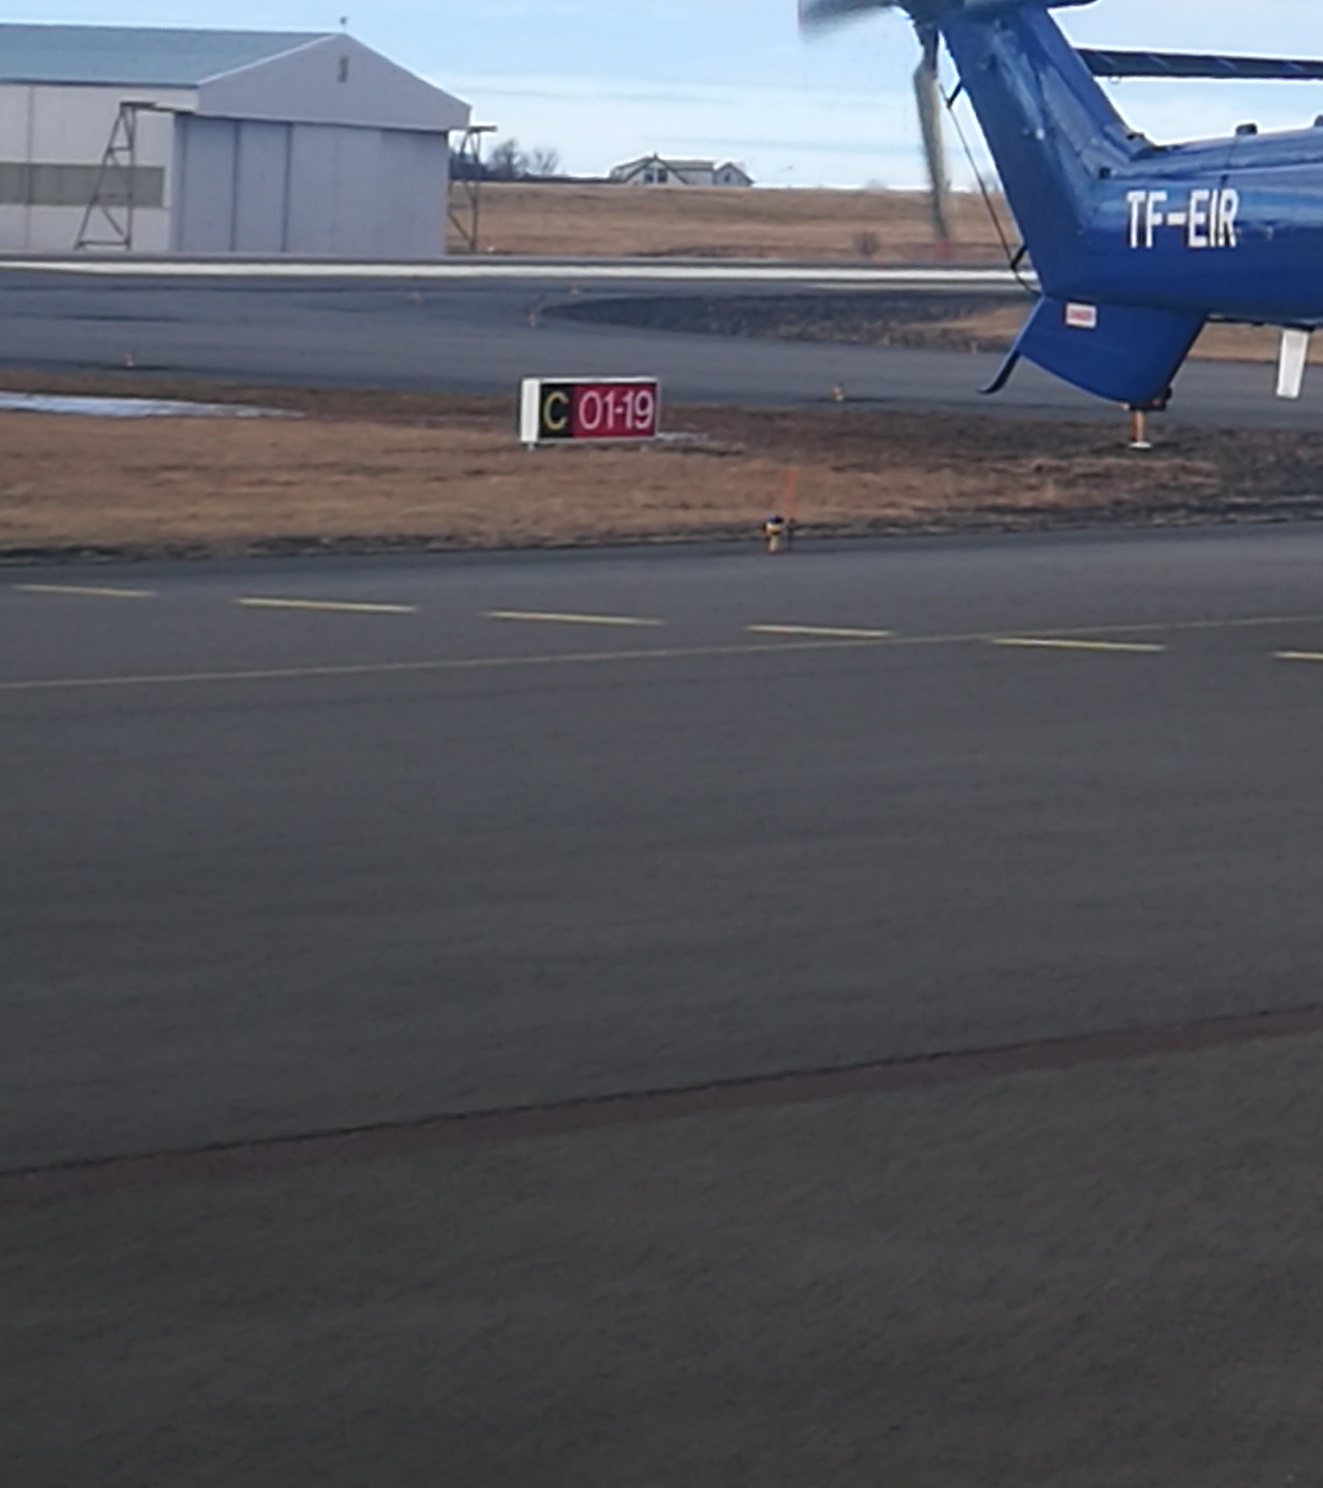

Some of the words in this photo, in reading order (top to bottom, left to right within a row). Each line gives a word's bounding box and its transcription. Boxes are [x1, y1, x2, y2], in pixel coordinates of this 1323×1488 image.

[1126, 189, 1238, 248] TF-EIR
[543, 392, 569, 430] C
[579, 390, 654, 430] 01-19
